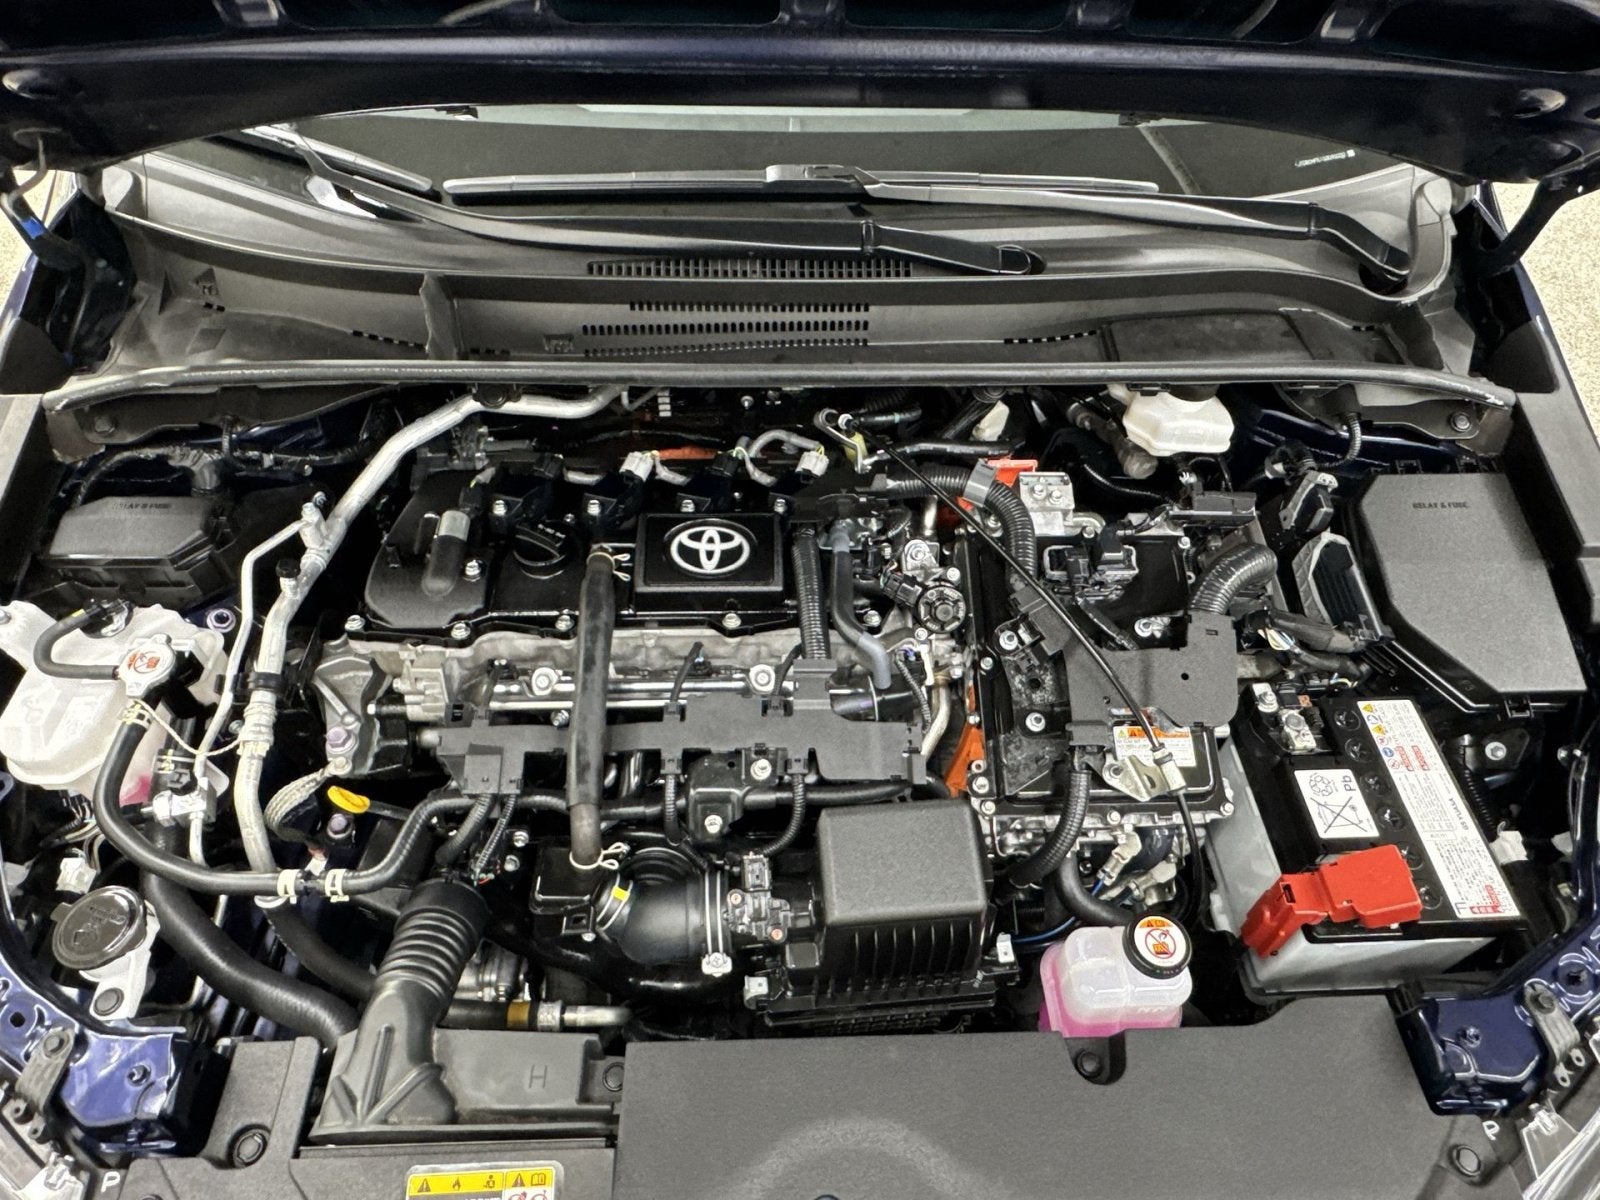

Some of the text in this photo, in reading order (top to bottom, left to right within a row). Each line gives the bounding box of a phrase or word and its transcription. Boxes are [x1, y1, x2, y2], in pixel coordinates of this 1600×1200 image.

[1340, 775, 1357, 792] Pb
[1448, 798, 1464, 821] YUASA
[528, 1064, 548, 1089] H
[1482, 1120, 1500, 1140] P
[101, 1171, 120, 1192] P
